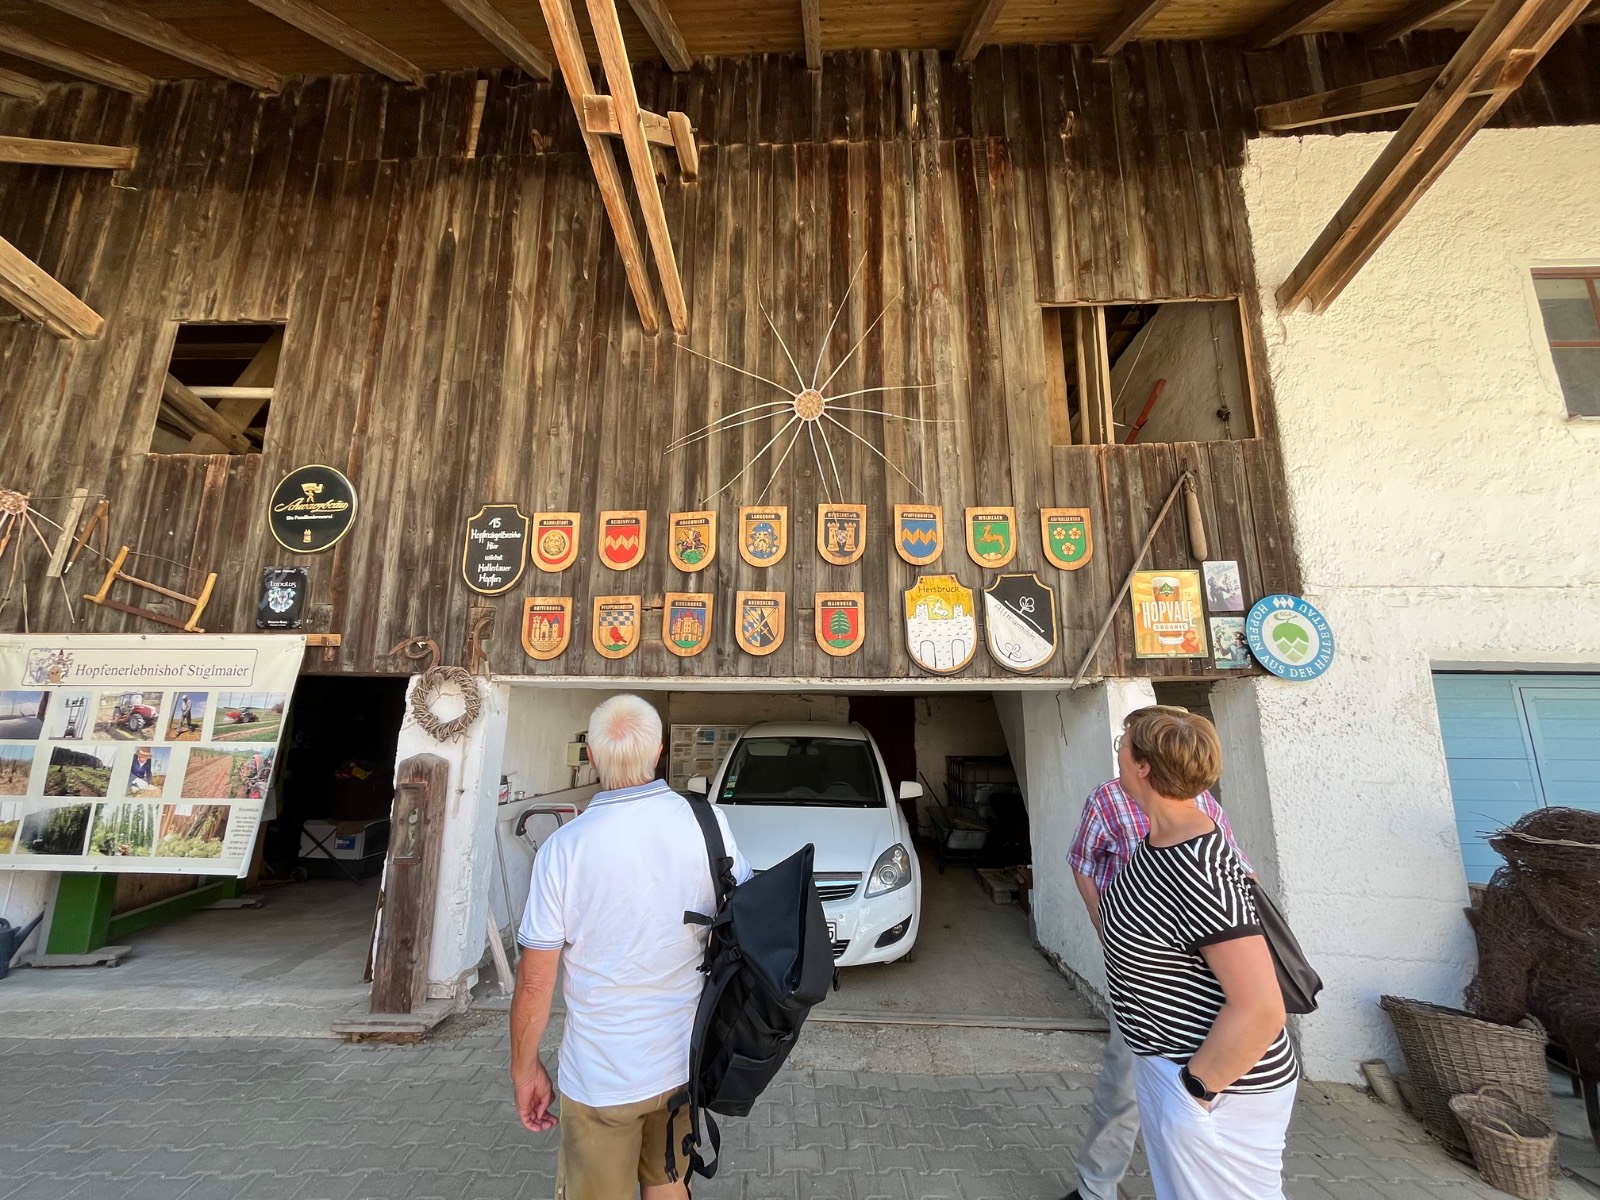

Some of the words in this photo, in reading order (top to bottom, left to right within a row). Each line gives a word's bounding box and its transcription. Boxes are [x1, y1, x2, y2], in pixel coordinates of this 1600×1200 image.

[488, 517, 502, 529] 15
[486, 541, 499, 550] Hier
[477, 563, 512, 573] Hallertauer
[478, 573, 502, 587] Hopfen
[918, 584, 961, 593] Hersbruck
[1142, 600, 1197, 629] HOPVALE
[994, 603, 1036, 641] Altmannstein
[1249, 604, 1269, 652] HOPFEN
[1298, 604, 1332, 670] HALLERTAU
[75, 664, 187, 679] Hopfenerlebnishof
[188, 664, 249, 679] Stiglmaier
[1260, 655, 1285, 674] AUS
[1290, 667, 1316, 678] DER
